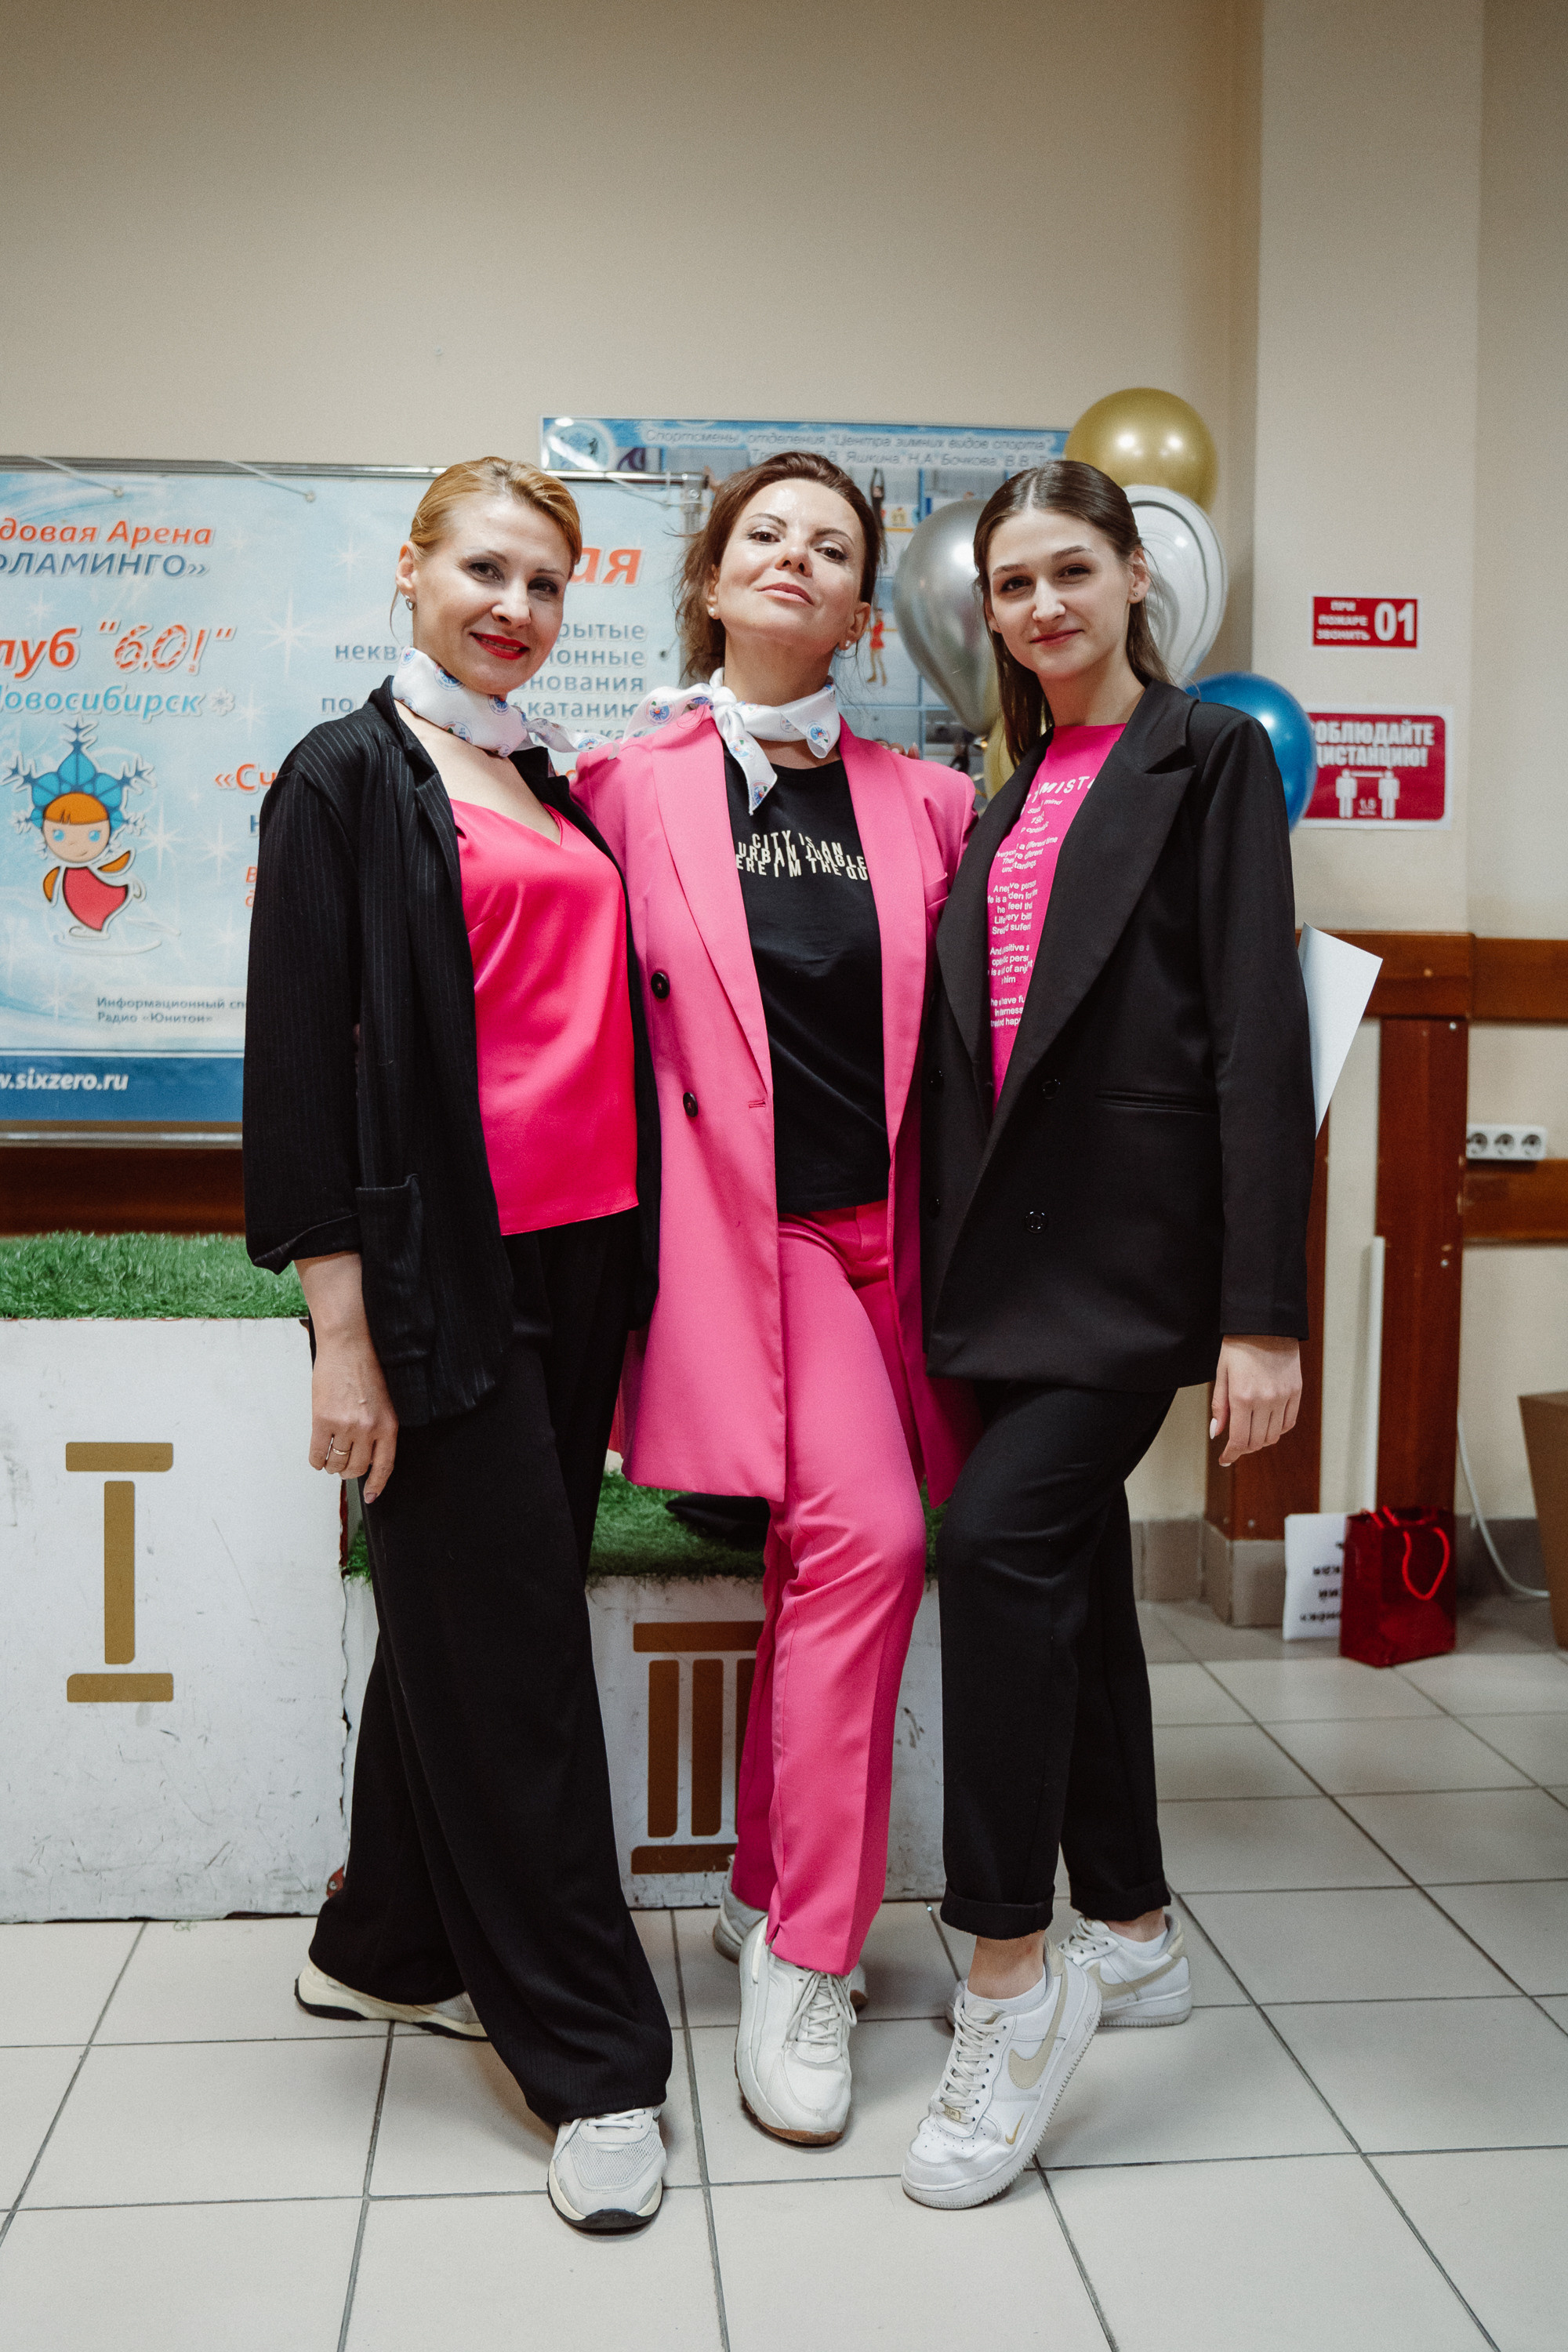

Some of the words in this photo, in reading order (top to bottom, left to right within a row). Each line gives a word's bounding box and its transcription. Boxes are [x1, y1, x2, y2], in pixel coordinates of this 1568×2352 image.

[107, 521, 212, 550] Арена
[570, 547, 642, 585] ая
[1330, 601, 1356, 612] ПРИ
[1318, 615, 1368, 626] ПОЖАРЕ
[1374, 601, 1414, 641] 01
[557, 623, 646, 643] рытые
[1316, 629, 1370, 641] ЗВОНИТЬ
[335, 644, 396, 661] некв
[550, 649, 646, 666] онные
[520, 676, 644, 692] нования
[322, 698, 353, 713] по
[1312, 720, 1435, 748] ОБЛЮДАЙТЕ
[752, 830, 791, 849] CITY
[798, 833, 814, 848] IS
[821, 840, 843, 856] AN
[738, 842, 797, 867] URBAN
[735, 855, 767, 876] ERE
[808, 858, 842, 877] THE
[846, 867, 869, 881] QU
[98, 1011, 137, 1023] Радио
